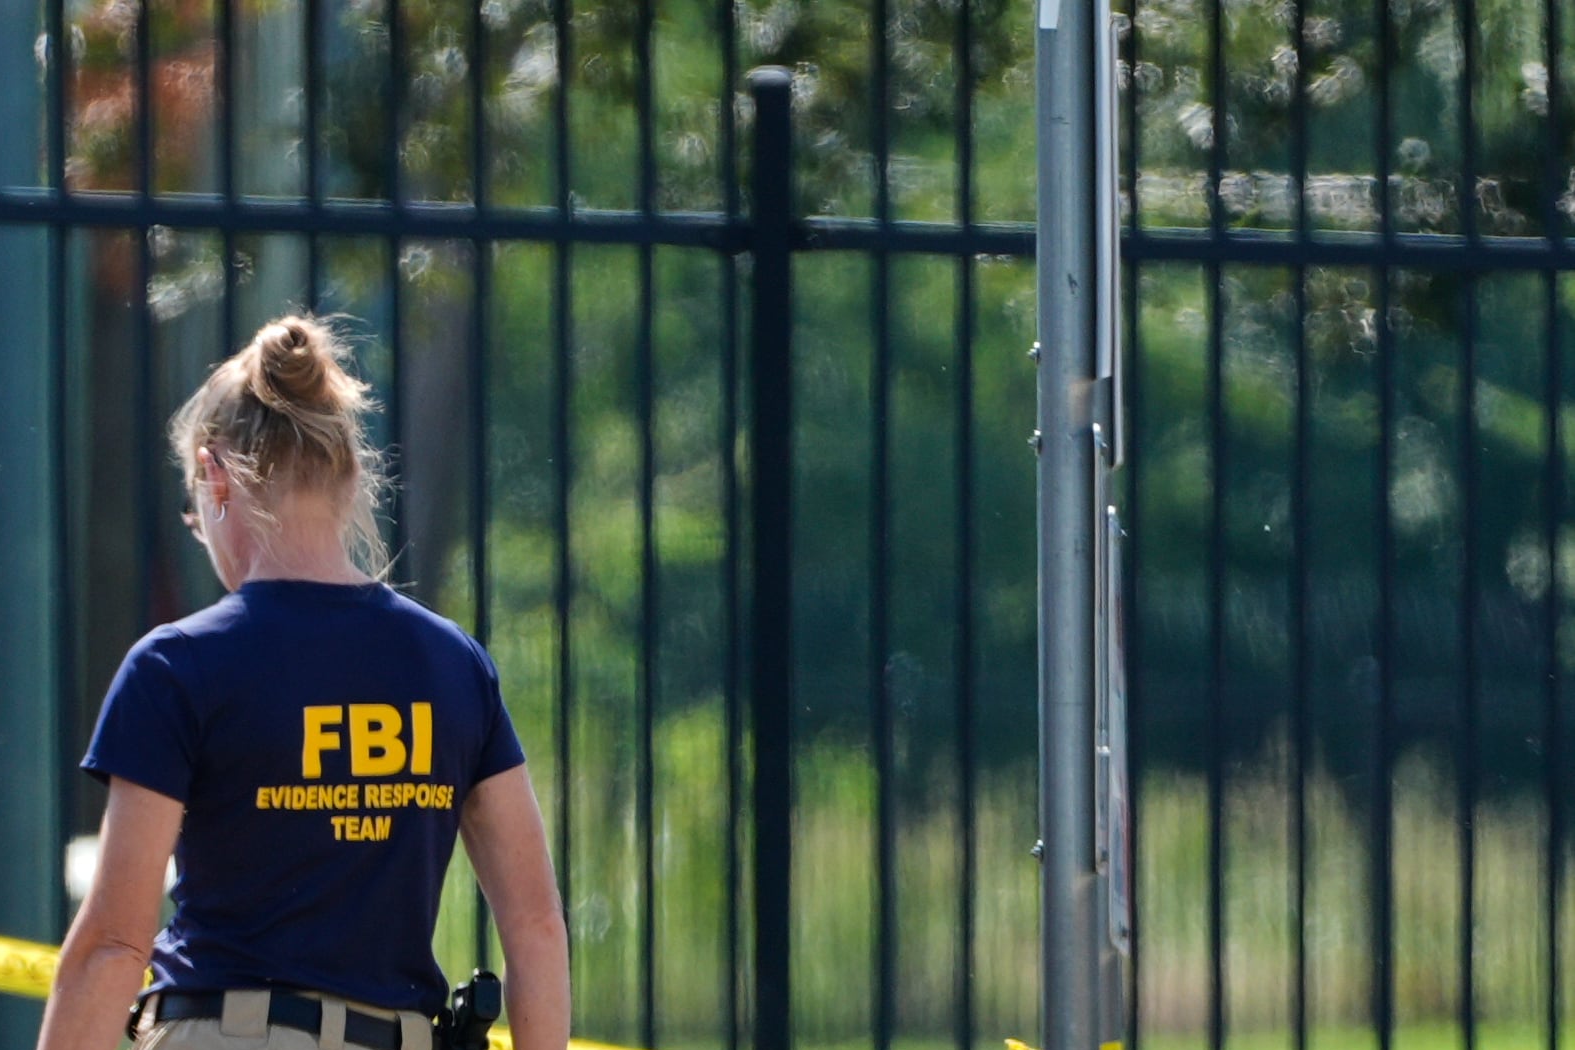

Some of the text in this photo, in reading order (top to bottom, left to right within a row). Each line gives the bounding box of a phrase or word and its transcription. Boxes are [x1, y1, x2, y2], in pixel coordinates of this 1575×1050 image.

[302, 701, 433, 779] FBI
[256, 782, 454, 810] EVIDENCE RESPONSE
[330, 815, 392, 841] TEAM
